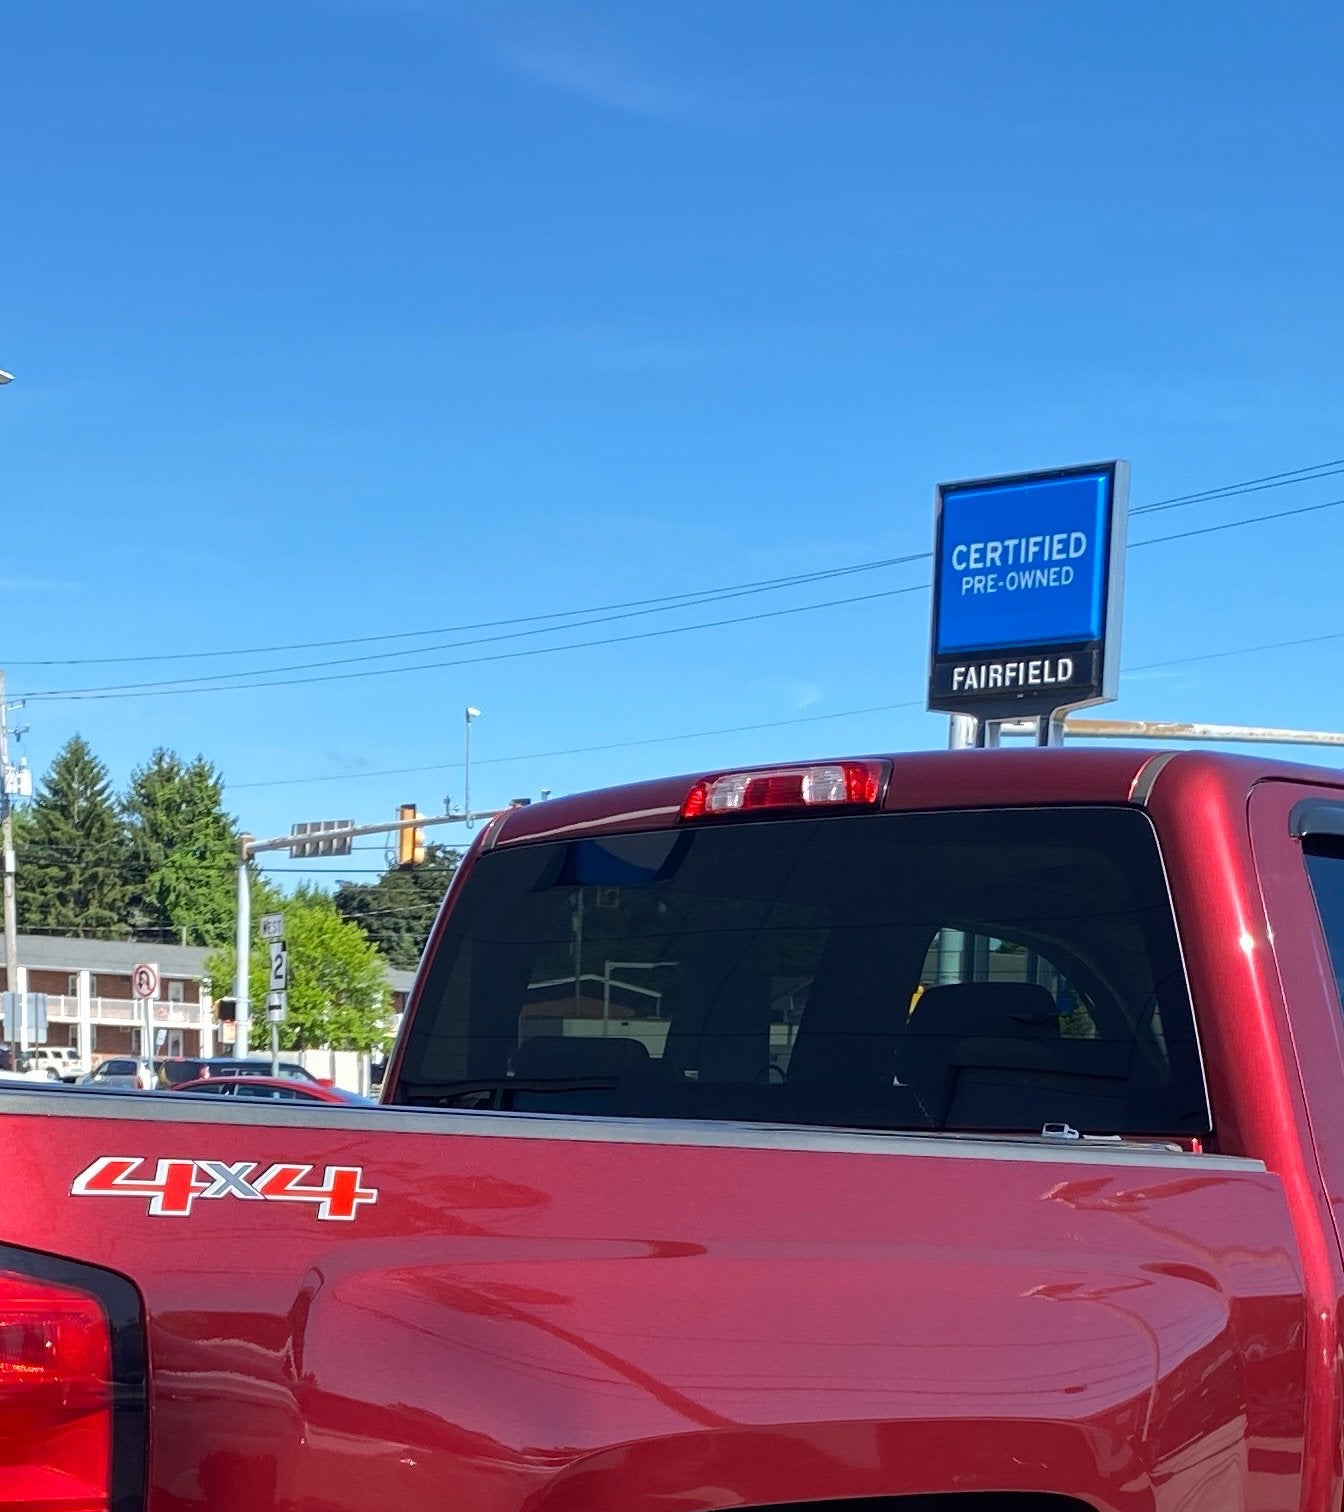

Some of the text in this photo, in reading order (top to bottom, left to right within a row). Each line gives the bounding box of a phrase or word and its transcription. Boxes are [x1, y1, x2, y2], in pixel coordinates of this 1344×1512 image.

[951, 531, 1088, 572] CERTIFIED
[961, 565, 1075, 596] PRE-OWNED
[951, 657, 1074, 692] FAIRFIELD
[263, 919, 282, 935] WEST
